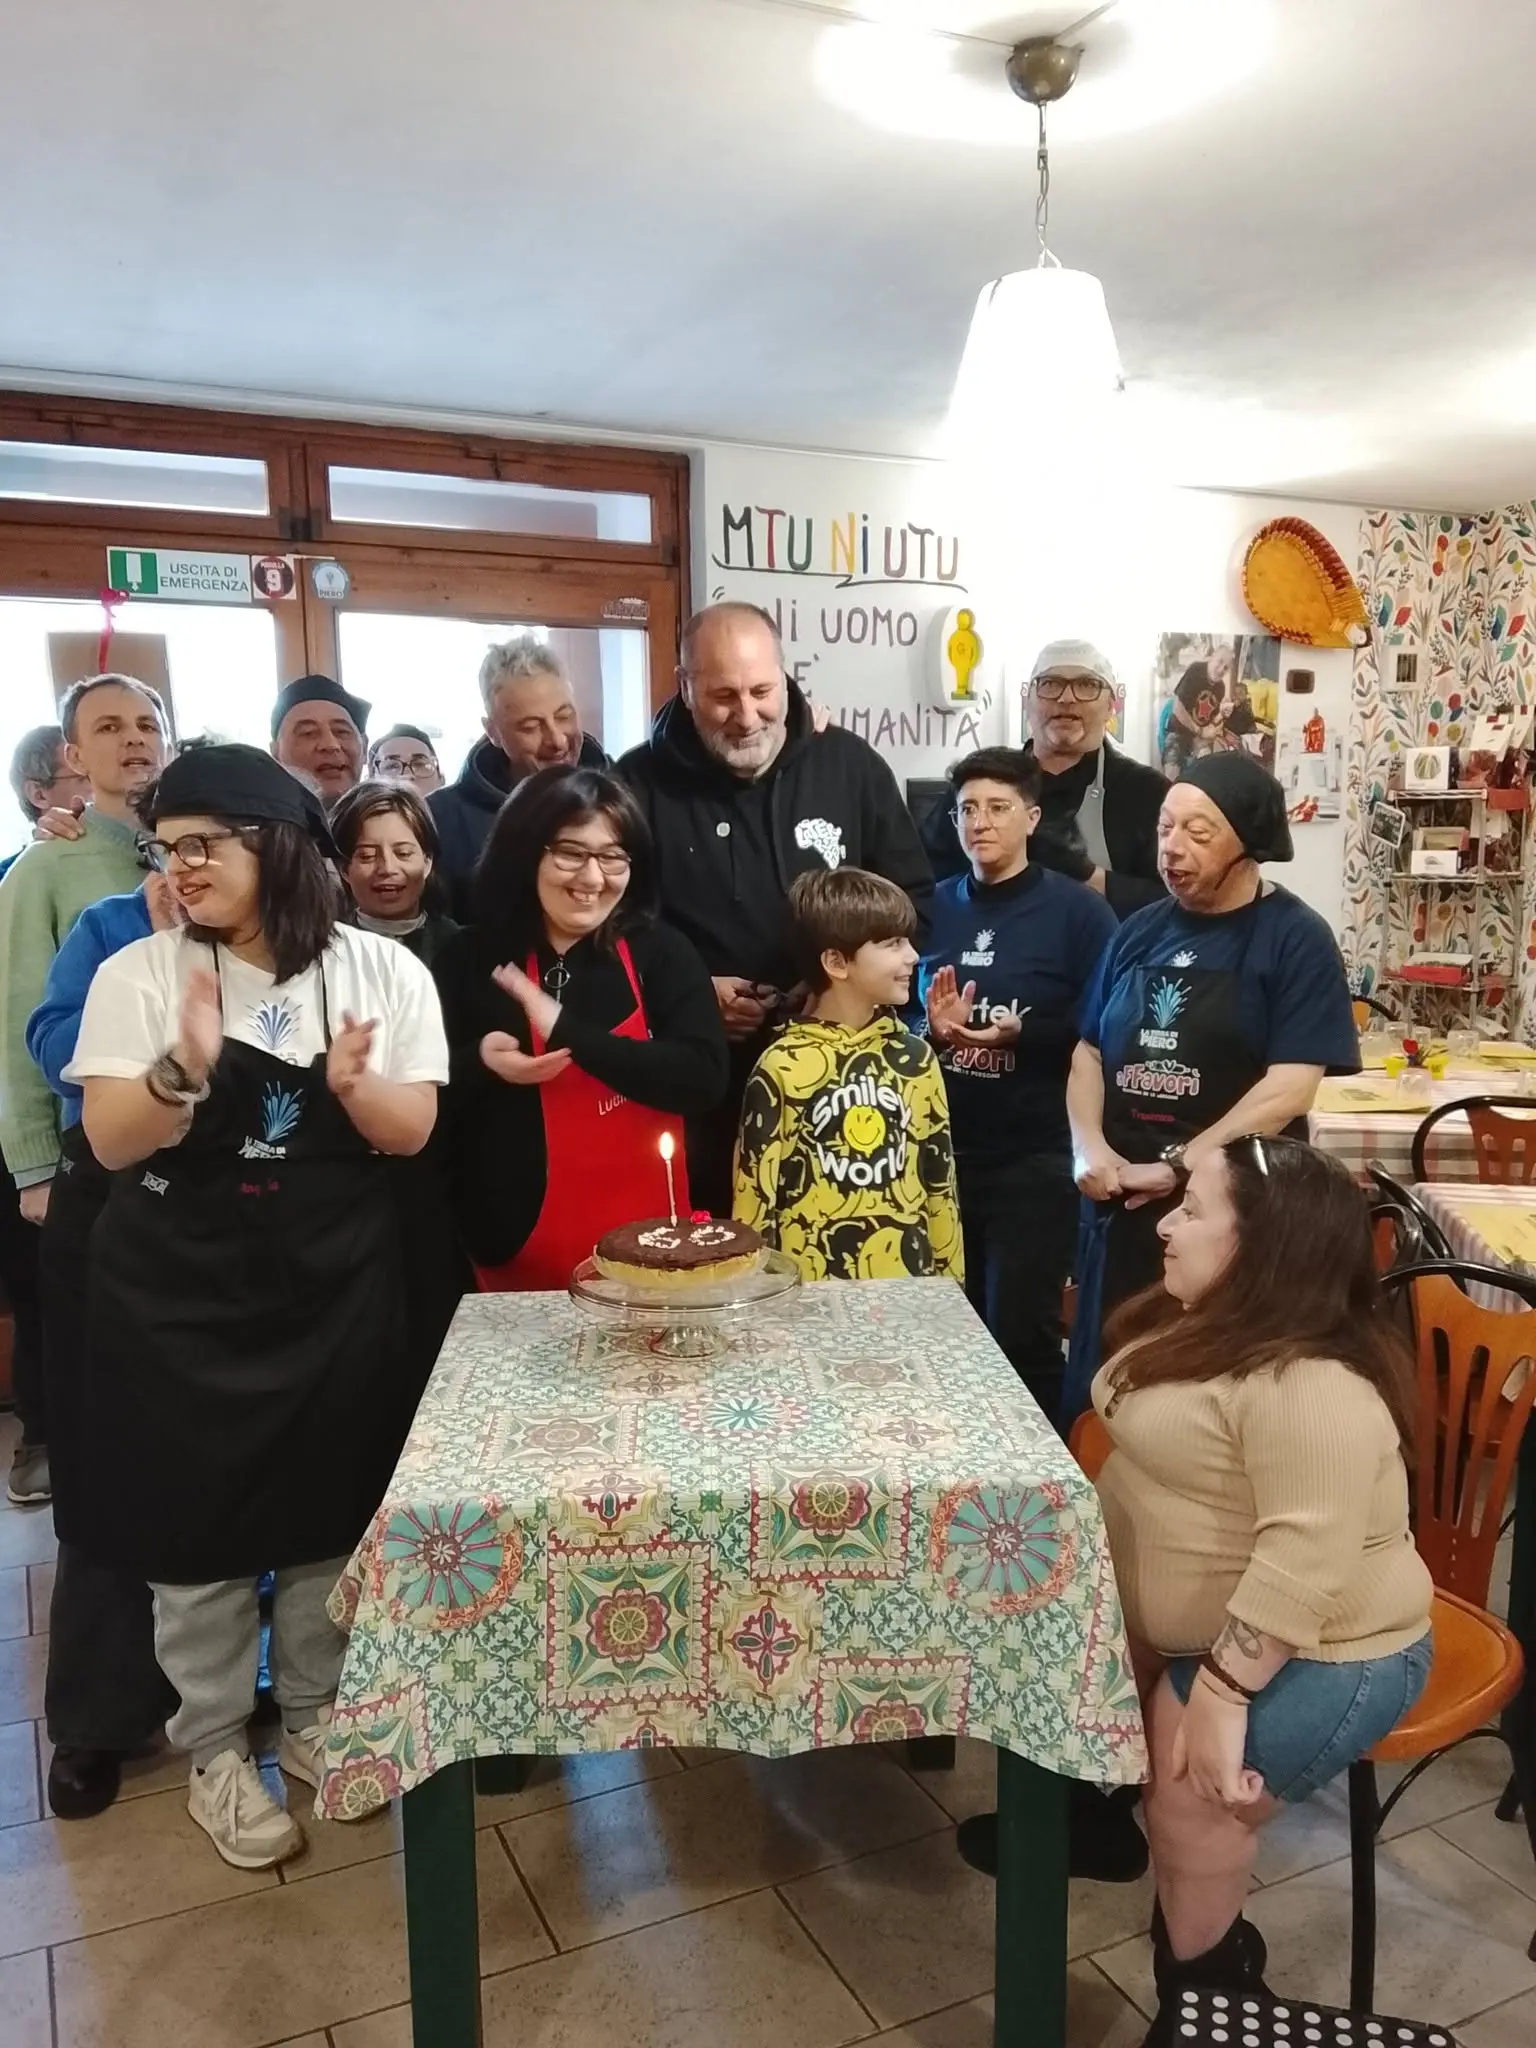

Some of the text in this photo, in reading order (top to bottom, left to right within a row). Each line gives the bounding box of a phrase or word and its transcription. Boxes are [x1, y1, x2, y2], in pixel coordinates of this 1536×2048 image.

[723, 504, 813, 572] MTU
[884, 522, 959, 581] UTU
[160, 576, 249, 593] EMERGENZA
[169, 563, 238, 577] USCITA DI
[821, 606, 918, 647] UOMO
